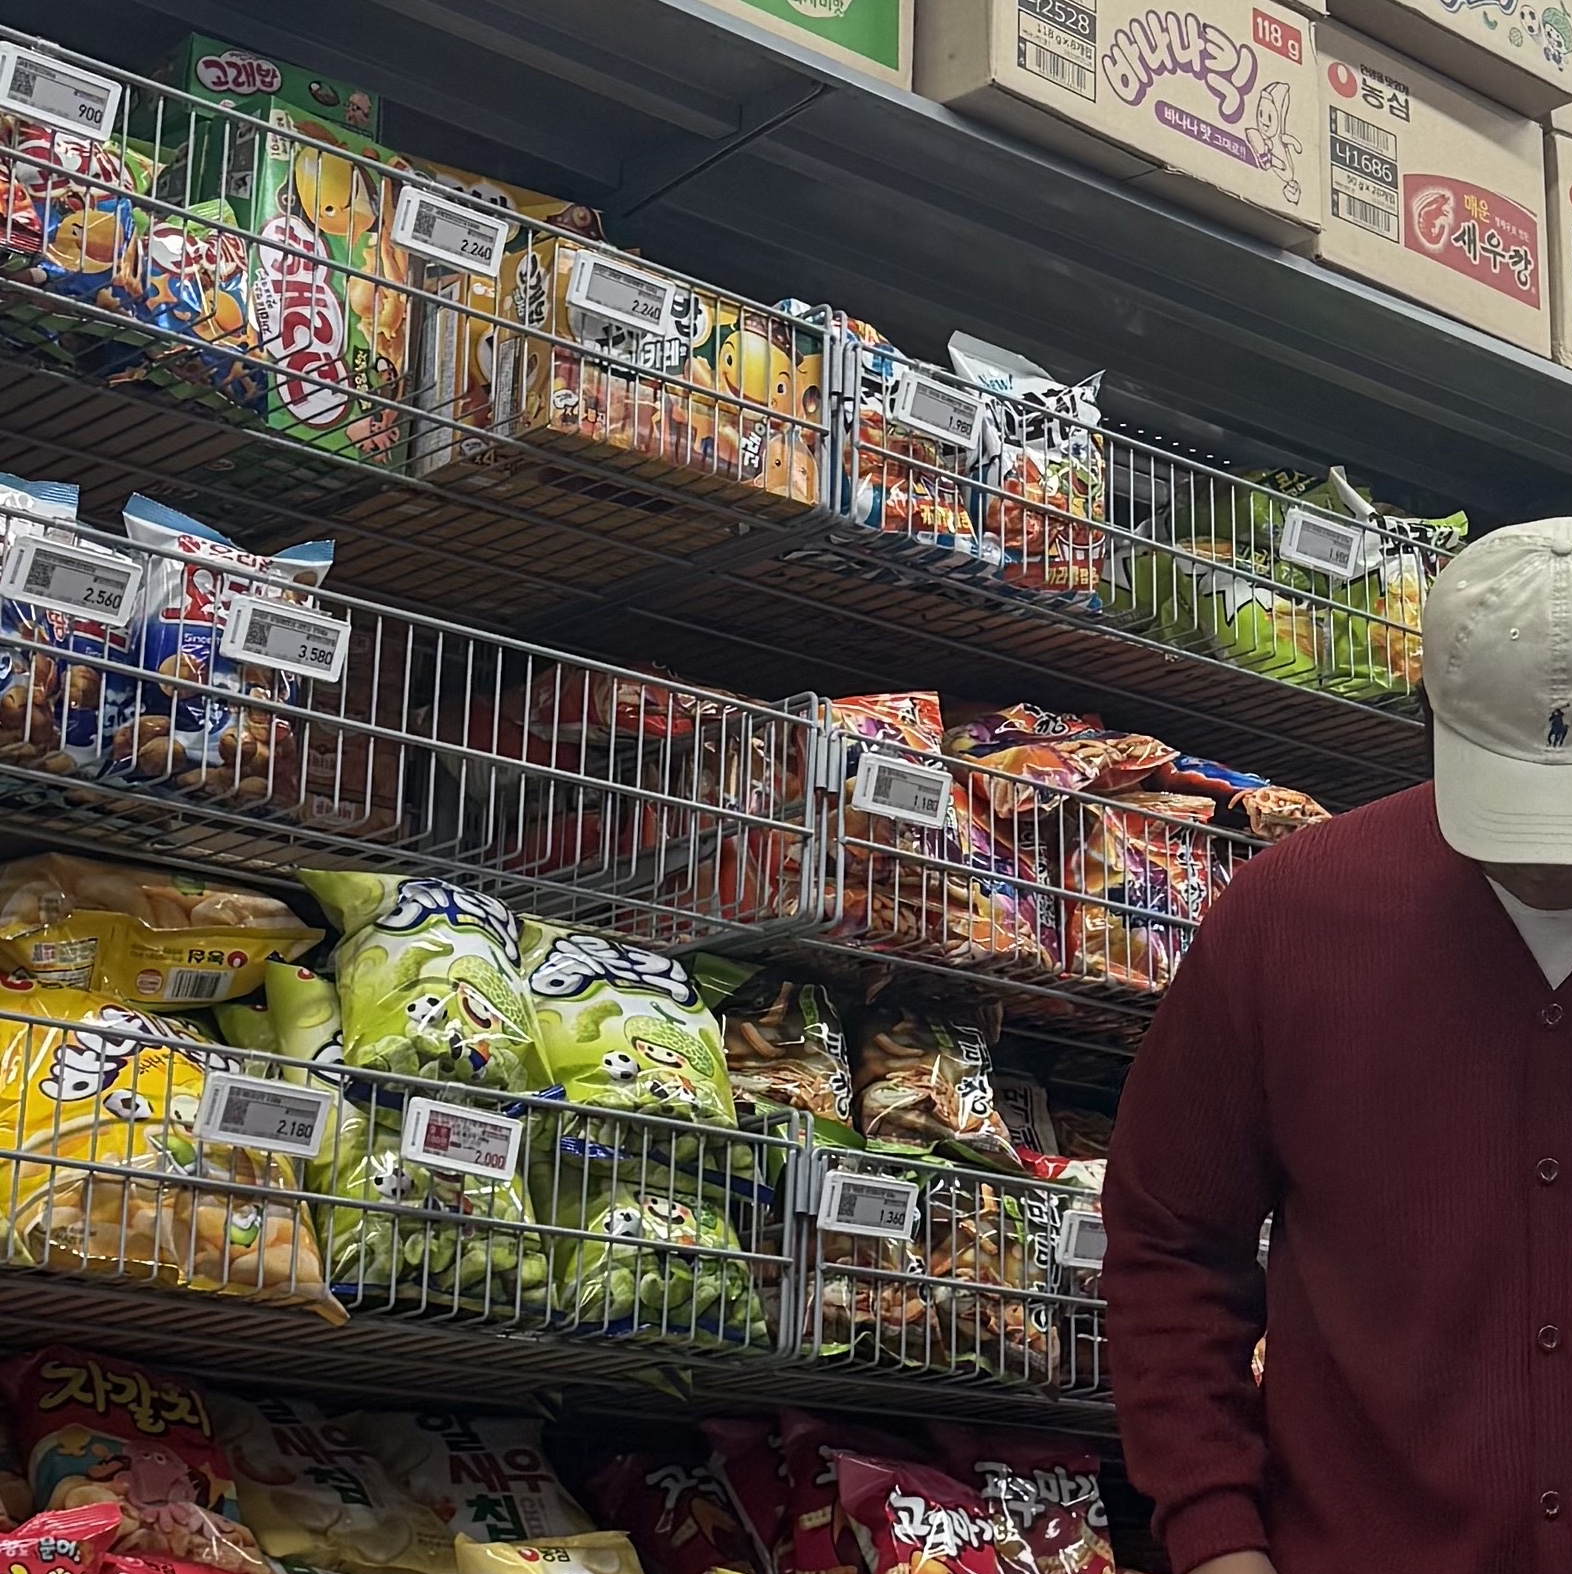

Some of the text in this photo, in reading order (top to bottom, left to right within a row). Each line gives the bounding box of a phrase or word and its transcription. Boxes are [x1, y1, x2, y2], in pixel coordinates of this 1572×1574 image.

[1256, 17, 1300, 61] 118 g
[201, 55, 280, 90] 고래밥
[1101, 9, 1258, 124] 바나나킥
[78, 103, 103, 124] 900
[1361, 78, 1410, 123] 농심
[1163, 105, 1199, 136] 바나나
[1199, 124, 1211, 142] 맛
[1336, 142, 1393, 183] 나1686
[1463, 194, 1490, 223] 매운
[1451, 220, 1536, 290] 새우깡
[270, 225, 341, 406] 고래밥
[40, 1361, 211, 1438] 자갈치
[449, 1448, 555, 1494] 새우
